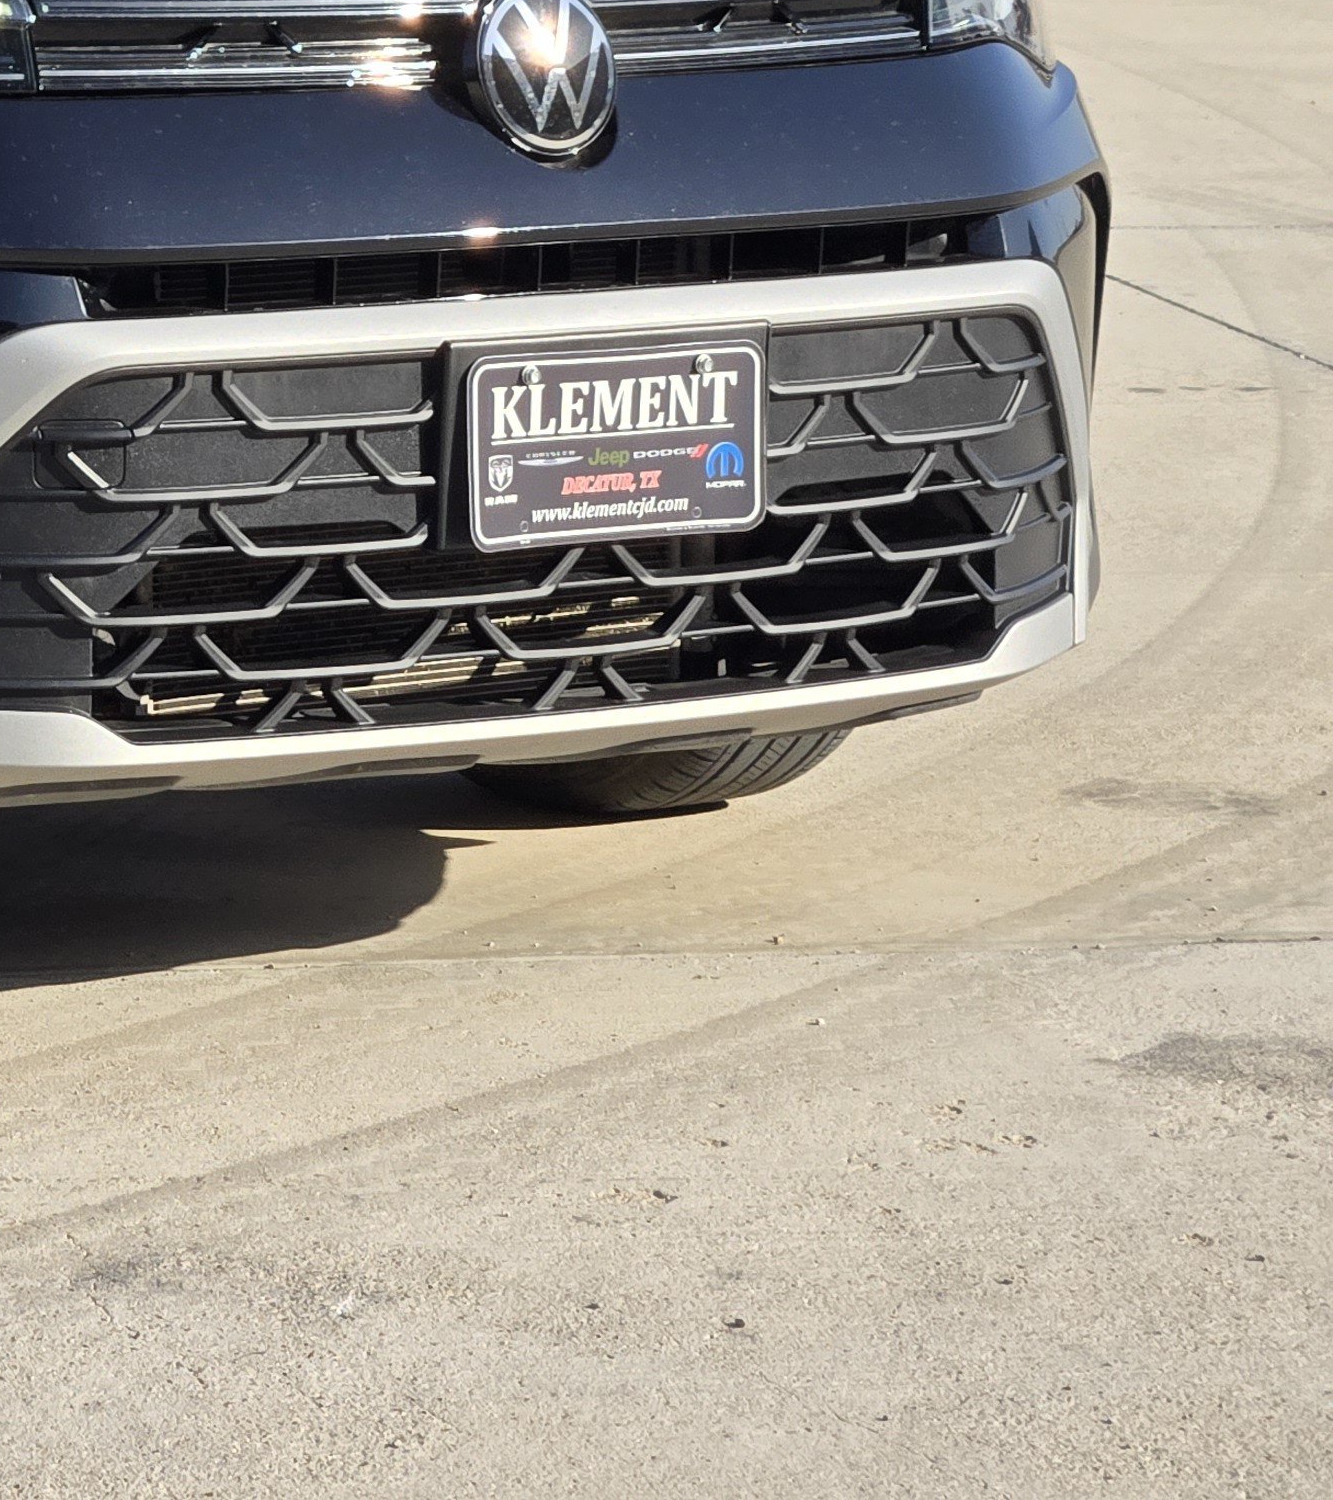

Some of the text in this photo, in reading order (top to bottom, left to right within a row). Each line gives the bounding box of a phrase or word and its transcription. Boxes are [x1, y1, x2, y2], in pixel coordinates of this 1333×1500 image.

[490, 370, 739, 440] KLEMENT
[587, 446, 631, 468] Jeep
[633, 445, 697, 459] DODGE
[560, 469, 663, 496] DECATUR, TX
[484, 493, 519, 508] RAM
[531, 495, 690, 524] www.klementcjd.com
